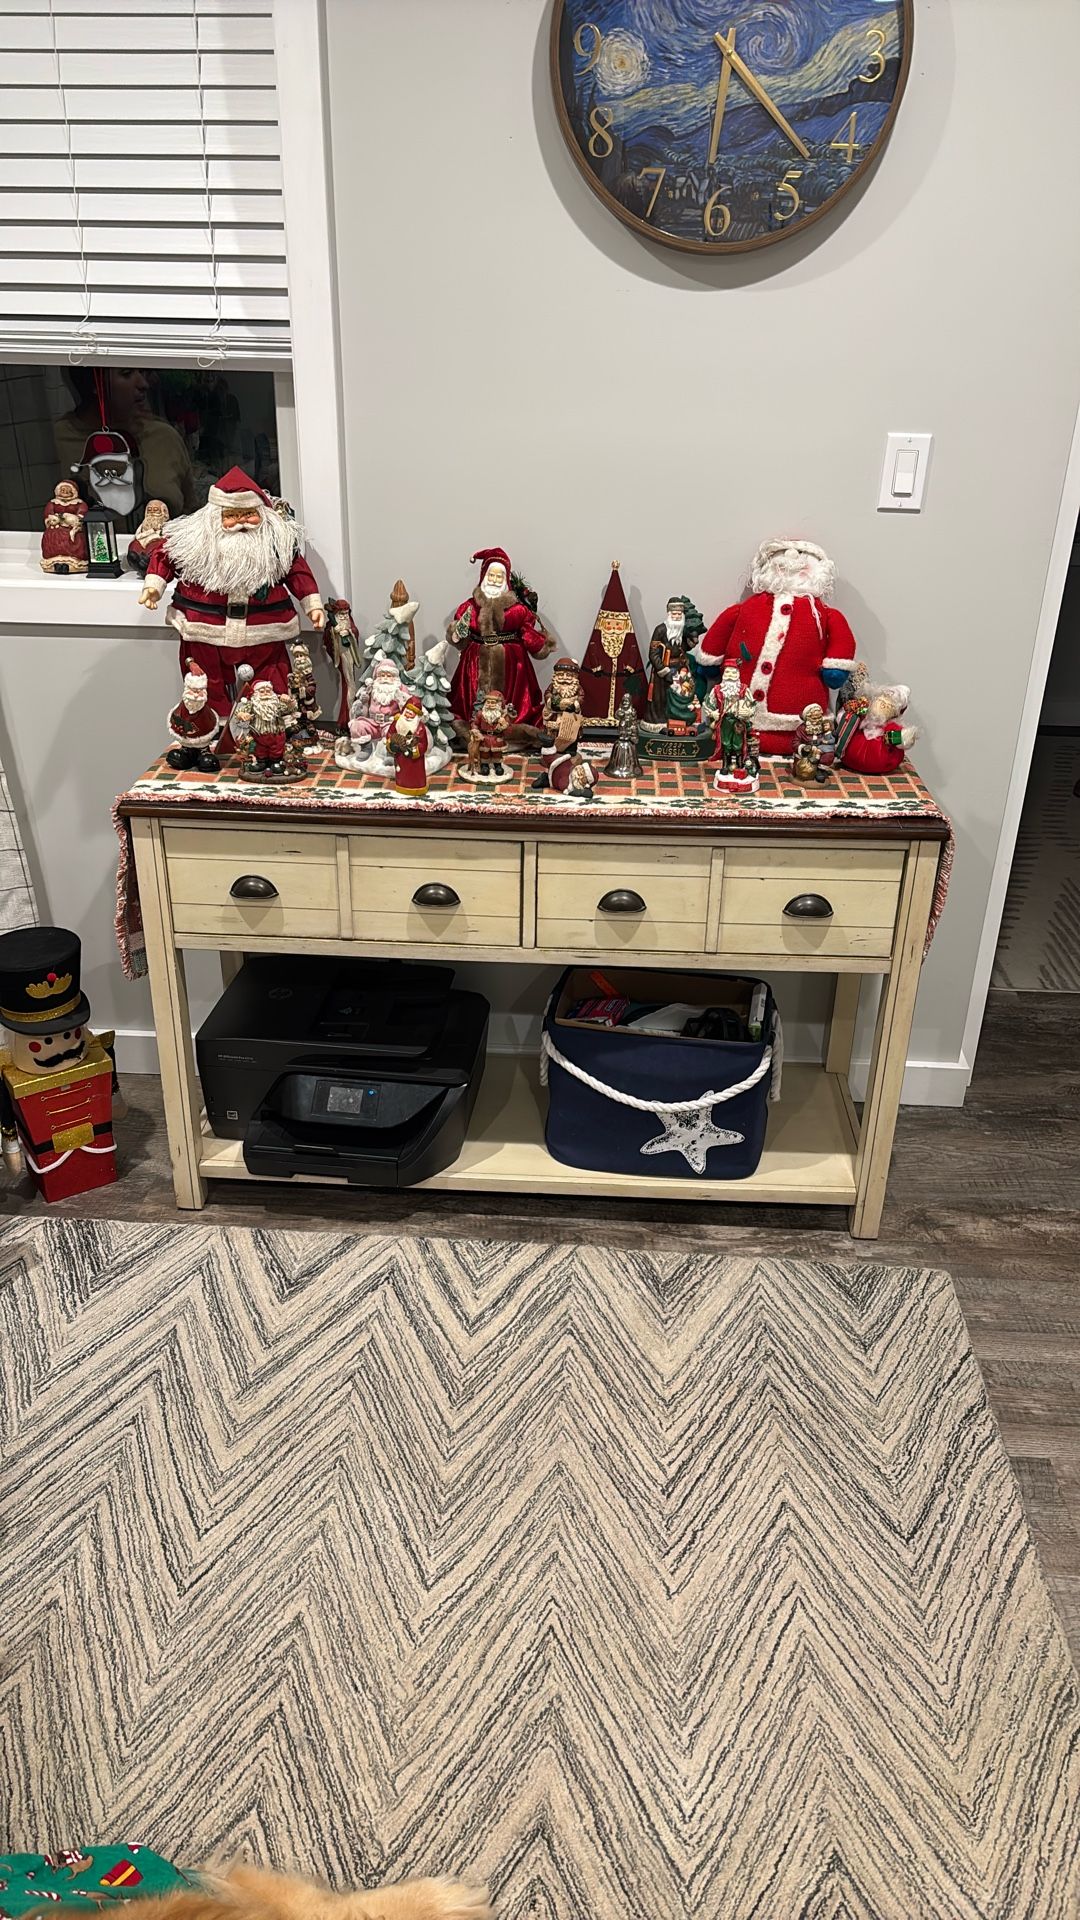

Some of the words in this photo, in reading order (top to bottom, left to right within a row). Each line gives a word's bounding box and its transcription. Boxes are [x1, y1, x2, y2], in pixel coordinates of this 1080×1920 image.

[574, 23, 602, 76] 9
[859, 29, 887, 83] 3
[589, 107, 614, 158] 8
[831, 111, 860, 163] 4
[641, 167, 666, 218] 7
[705, 185, 731, 236] 6
[774, 170, 803, 221] 5
[657, 747, 687, 756] RUSSIA
